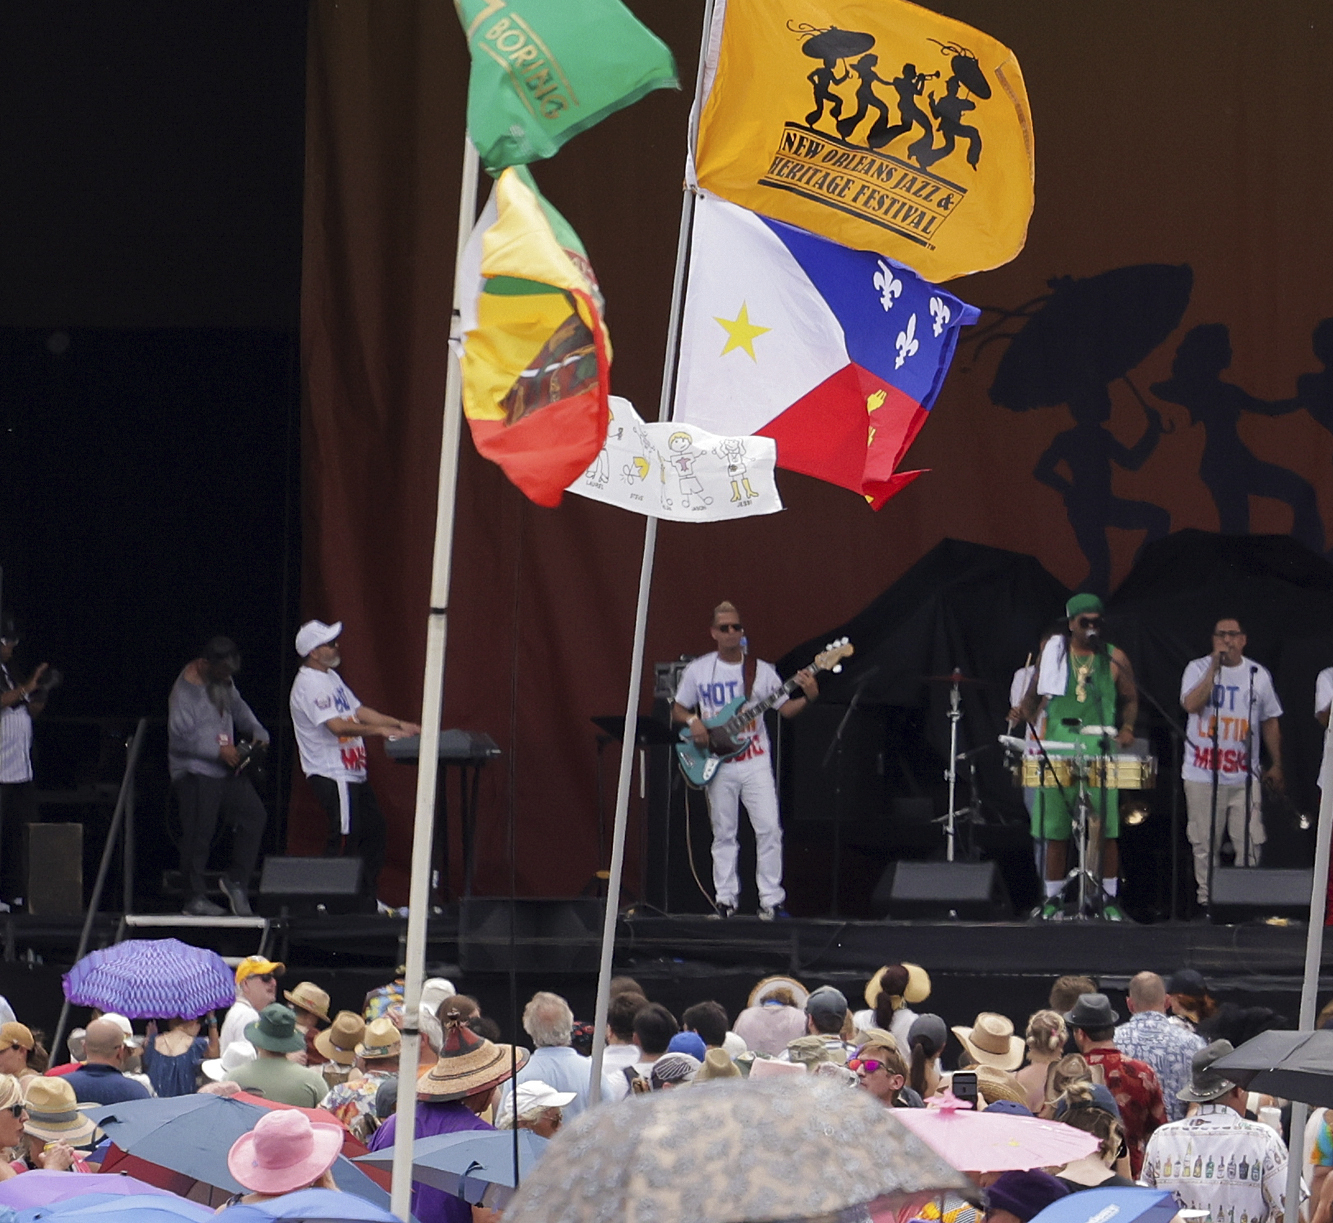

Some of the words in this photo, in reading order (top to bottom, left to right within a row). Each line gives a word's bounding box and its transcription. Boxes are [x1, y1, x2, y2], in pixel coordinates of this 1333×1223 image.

[769, 156, 854, 197] HERITAGE
[851, 186, 937, 235] FESTIVAL
[782, 132, 824, 161] NEW
[822, 150, 896, 183] ORLEANS
[892, 173, 939, 203] JAZZ
[936, 193, 954, 211] &
[699, 680, 738, 706] HOT
